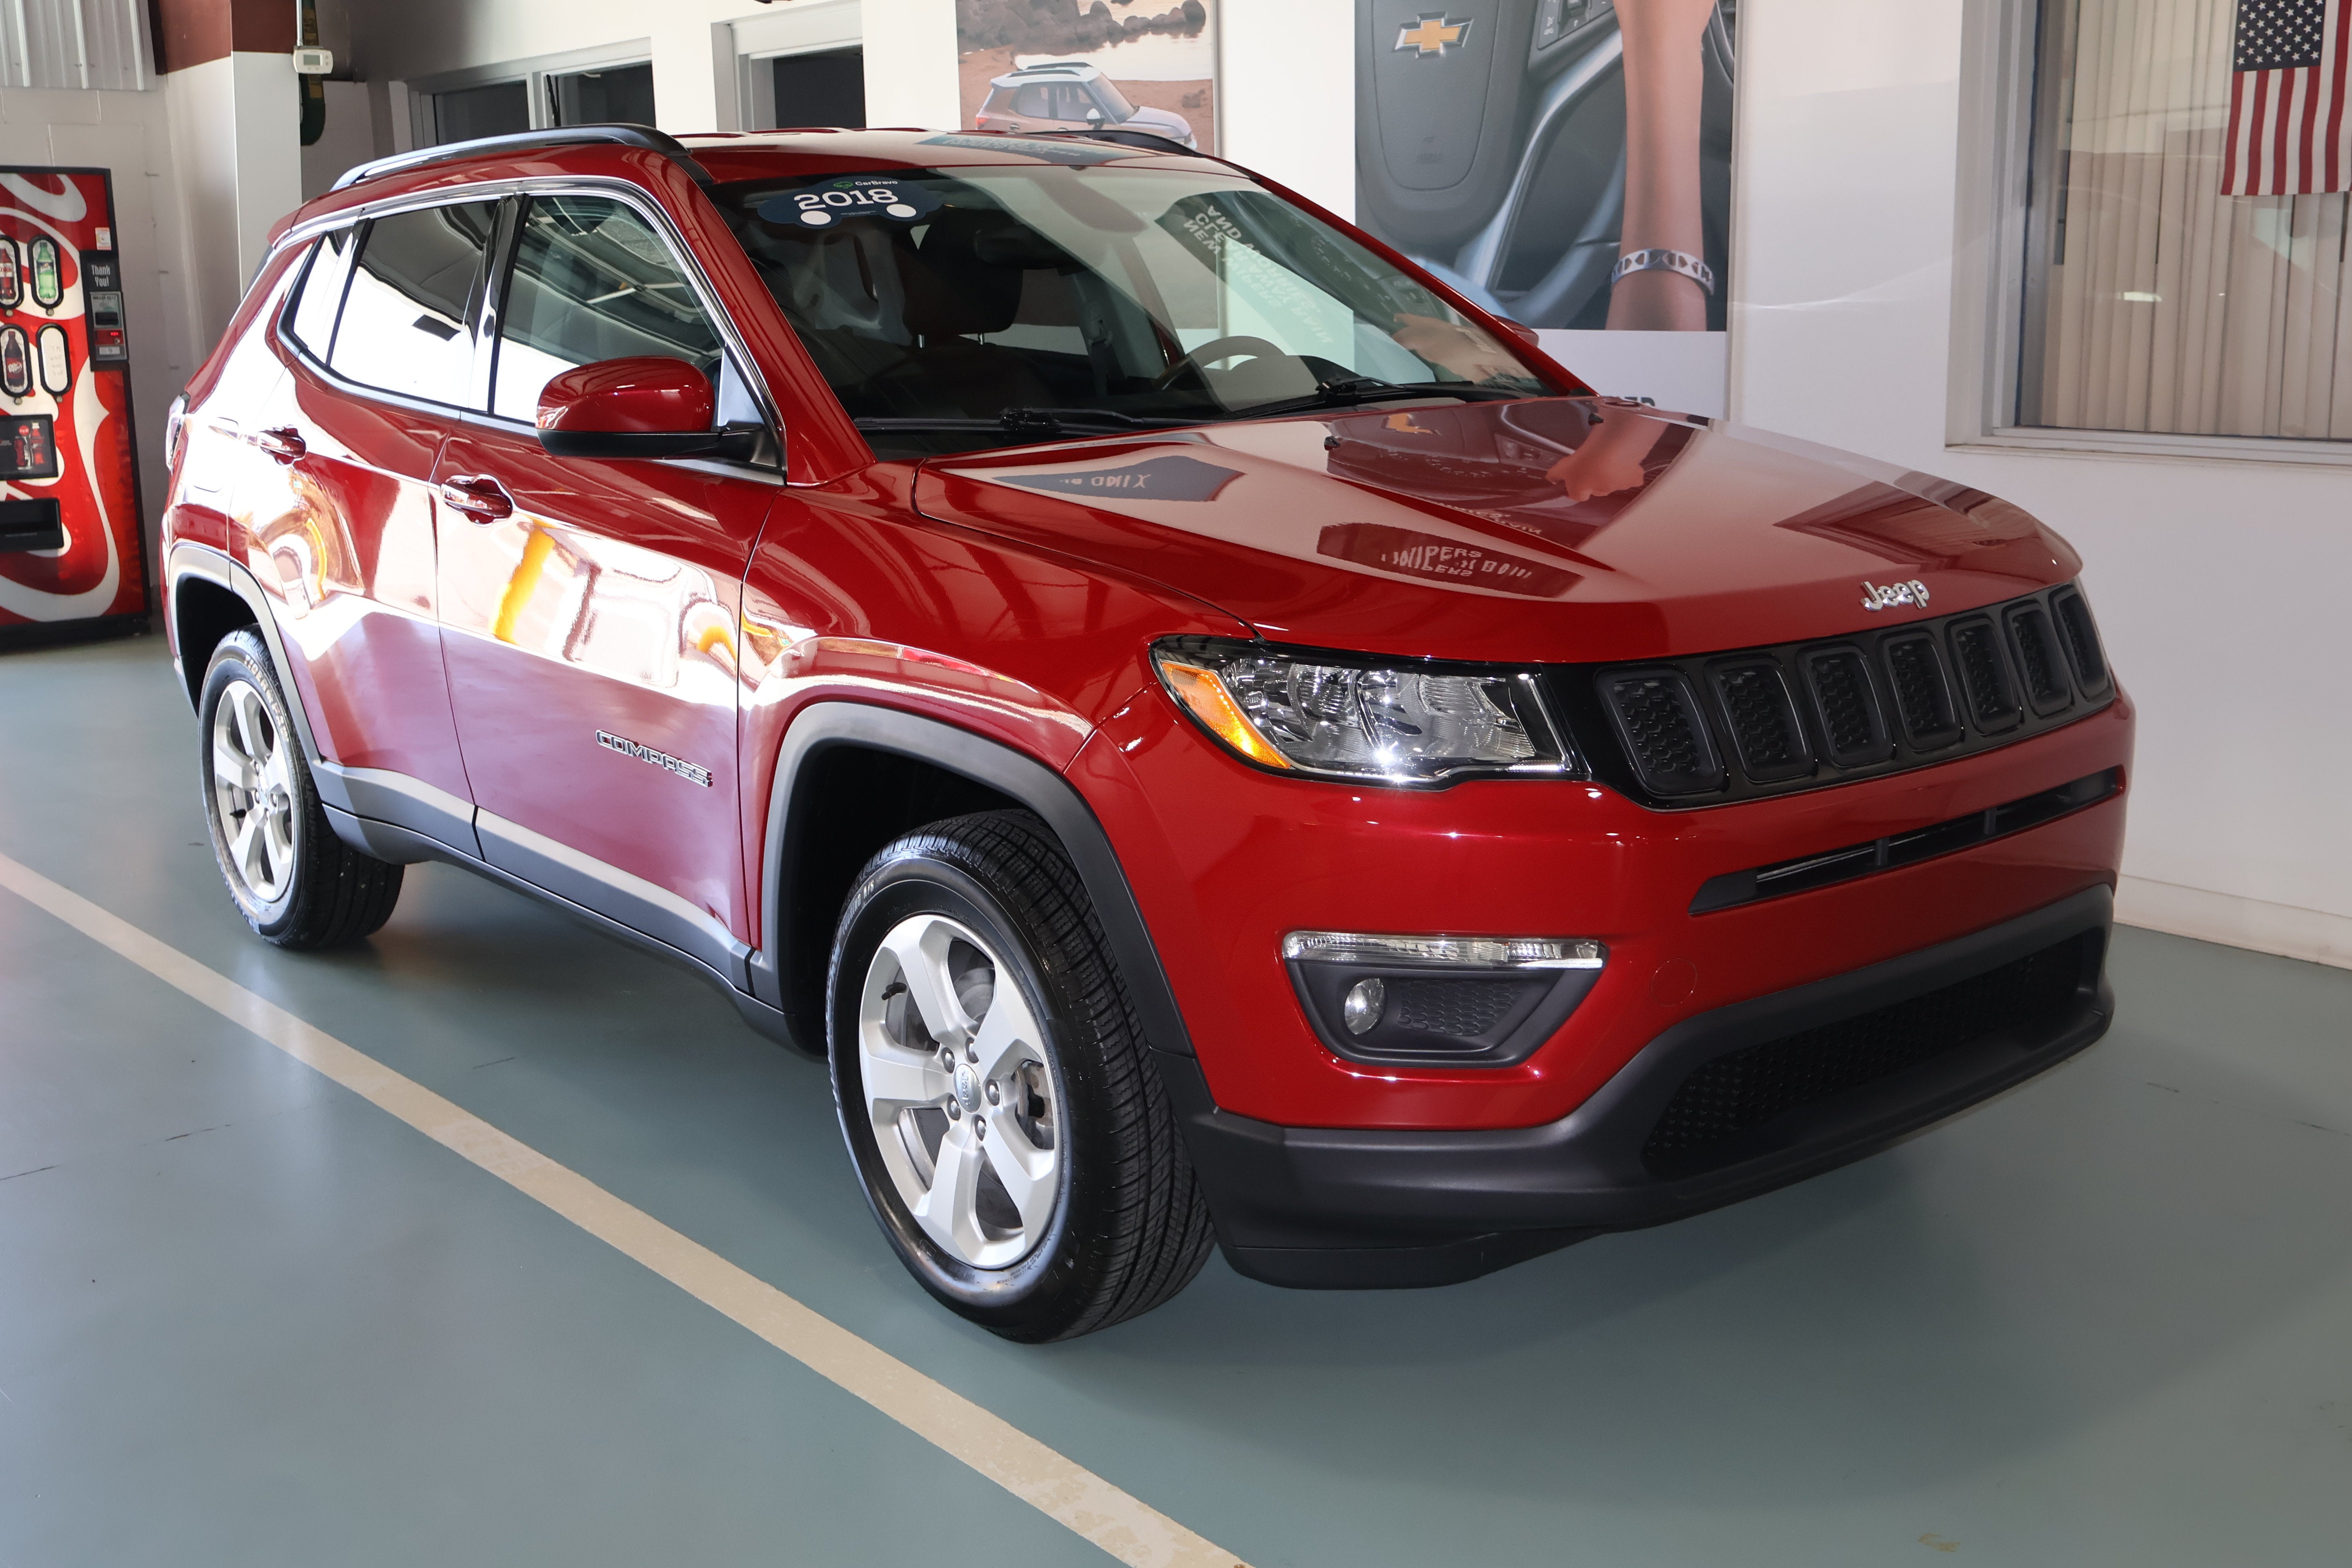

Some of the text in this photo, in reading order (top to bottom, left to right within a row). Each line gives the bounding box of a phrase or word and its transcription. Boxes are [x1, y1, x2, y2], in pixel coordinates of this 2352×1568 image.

[794, 188, 898, 210] 2018
[91, 265, 111, 276] Thank
[95, 276, 109, 287] You!
[1860, 579, 1930, 611] Jeep
[596, 729, 714, 787] COMPASS
